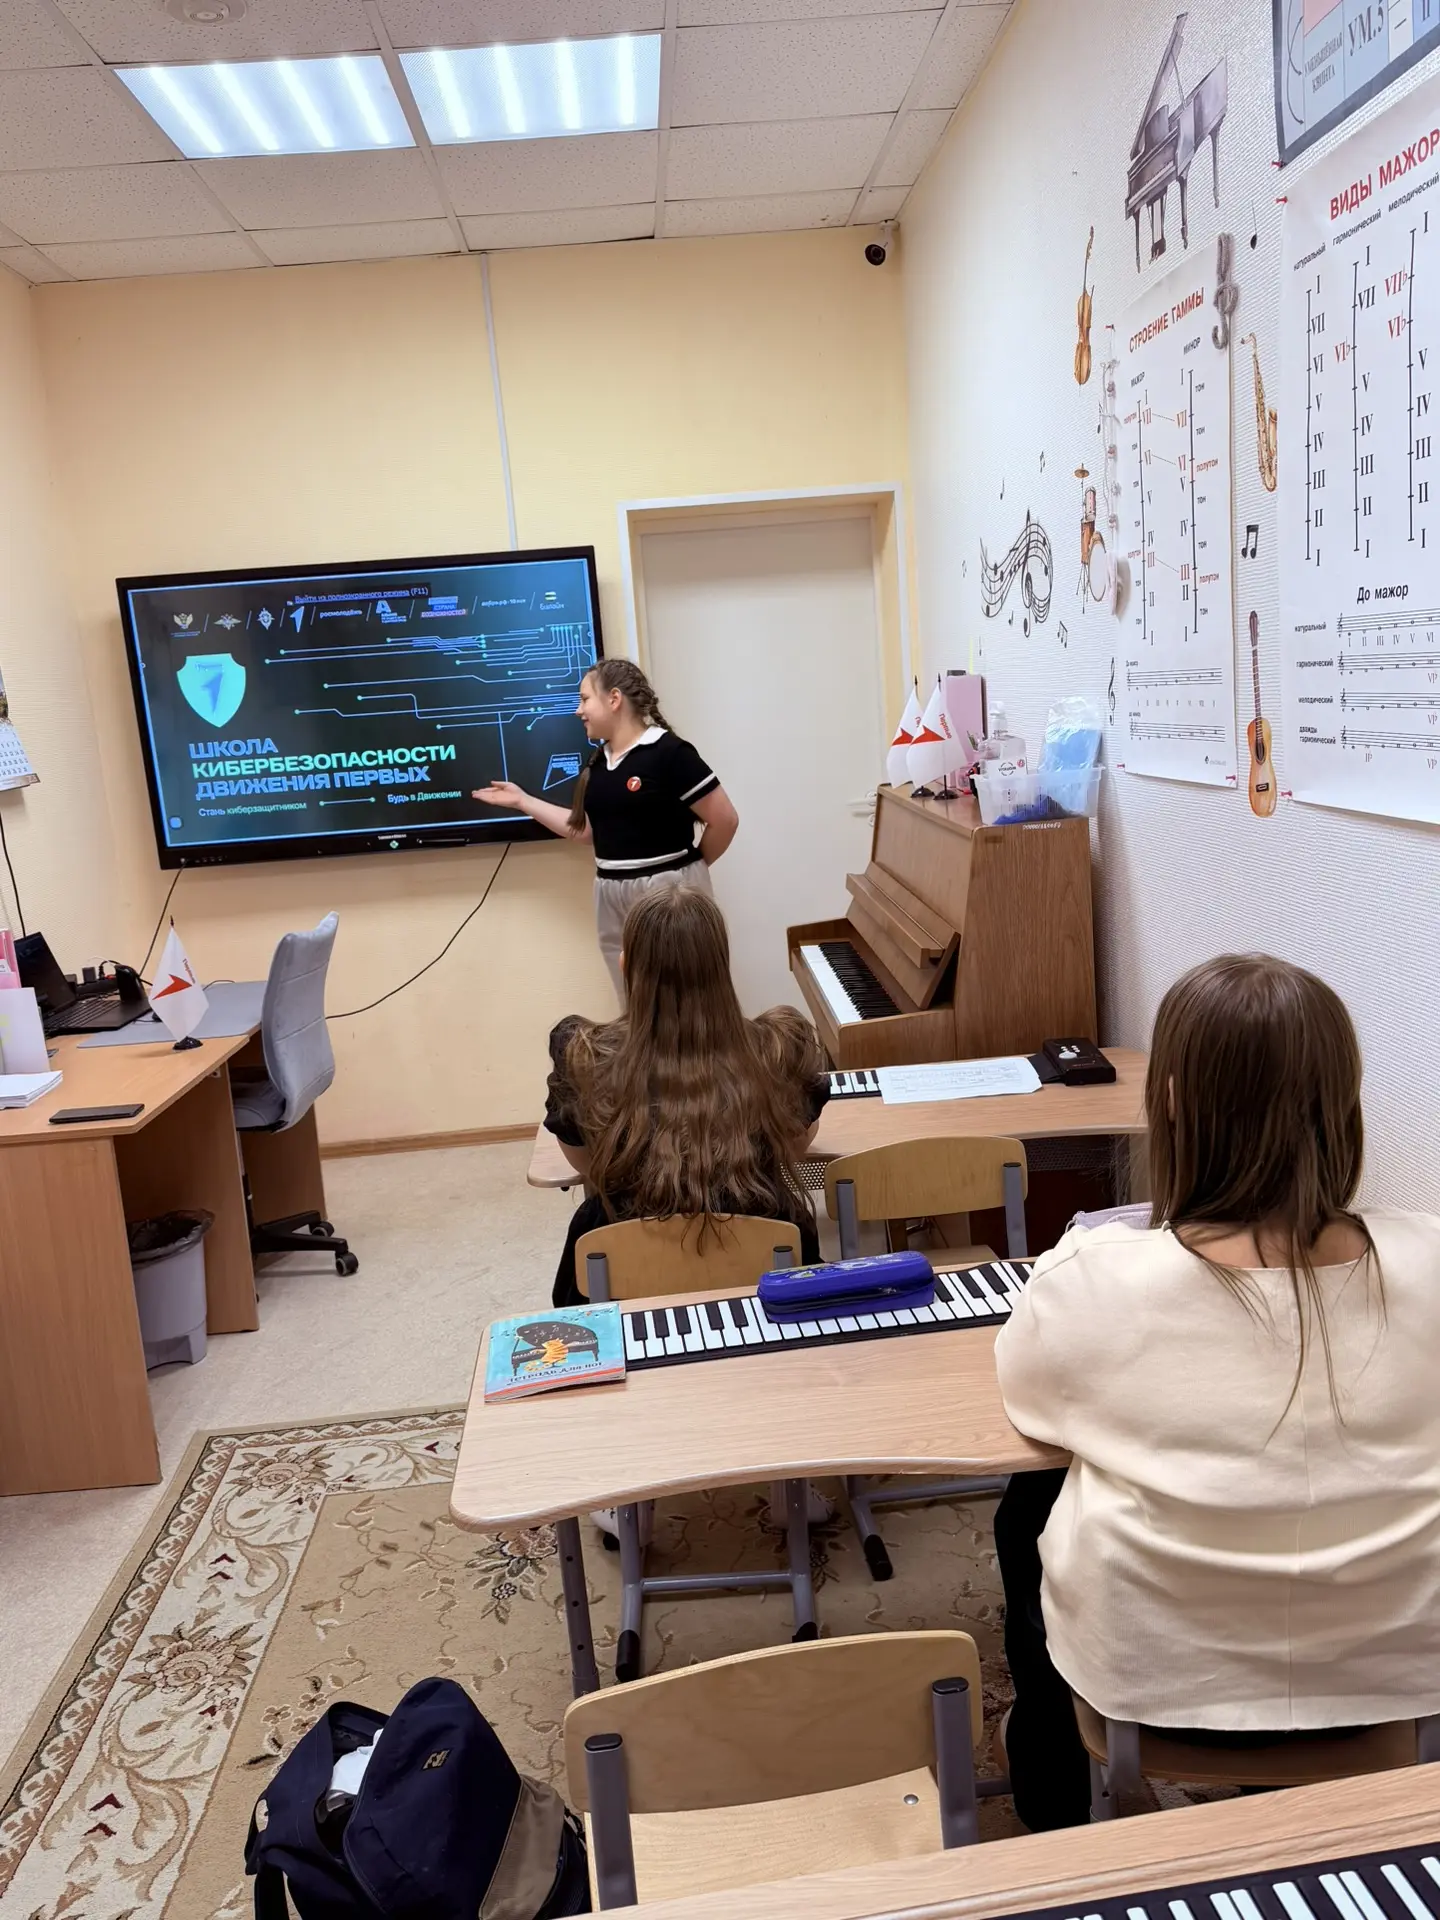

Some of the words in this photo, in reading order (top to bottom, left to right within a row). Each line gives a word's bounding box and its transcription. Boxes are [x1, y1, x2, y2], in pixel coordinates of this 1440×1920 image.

[1330, 174, 1373, 220] ВИДЫ
[1293, 242, 1327, 271] натуральный
[1332, 208, 1382, 246] гармонический
[1388, 171, 1440, 212] мелодический
[1423, 211, 1429, 233] I
[1365, 245, 1371, 266] I
[1358, 285, 1376, 311] VII
[1129, 312, 1169, 353] СТРОЕНИЕ
[1171, 287, 1204, 324] ГАММЫ
[1311, 312, 1325, 335] VII
[1313, 353, 1324, 375] VI
[1418, 348, 1428, 370] V
[1362, 372, 1371, 392] V
[1315, 393, 1323, 412] V
[1416, 392, 1432, 417] IV
[1176, 409, 1187, 428] VII
[1361, 413, 1374, 436] IV
[1313, 432, 1325, 453] IV
[1415, 436, 1432, 460] III
[1178, 454, 1186, 471] VI
[1360, 454, 1374, 476] III
[1313, 469, 1326, 490] III
[1418, 481, 1429, 504] II
[1363, 496, 1372, 516] II
[1180, 519, 1188, 537] IV
[1314, 508, 1323, 528] II
[1147, 530, 1155, 547] IV
[1147, 552, 1155, 568] III
[1180, 563, 1190, 581] III
[411, 587, 429, 596] (F11)
[1149, 591, 1155, 607] II
[1182, 584, 1189, 601] II
[1356, 586, 1371, 605] До
[1374, 584, 1409, 601] мажор
[1295, 622, 1327, 634] натуральный
[1296, 659, 1334, 668] гармонический
[188, 737, 278, 759] ШКОЛА
[192, 744, 456, 779] КИБЕРБЕЗОПАСНОСТИ
[196, 773, 330, 801] ДВИЖЕНИЯ
[334, 765, 431, 789] ПЕРВЫХ
[387, 793, 409, 804] Будь
[410, 794, 416, 802] в
[417, 790, 462, 801] Движении
[198, 806, 226, 817] Стань
[226, 801, 307, 816] киберзащитником
